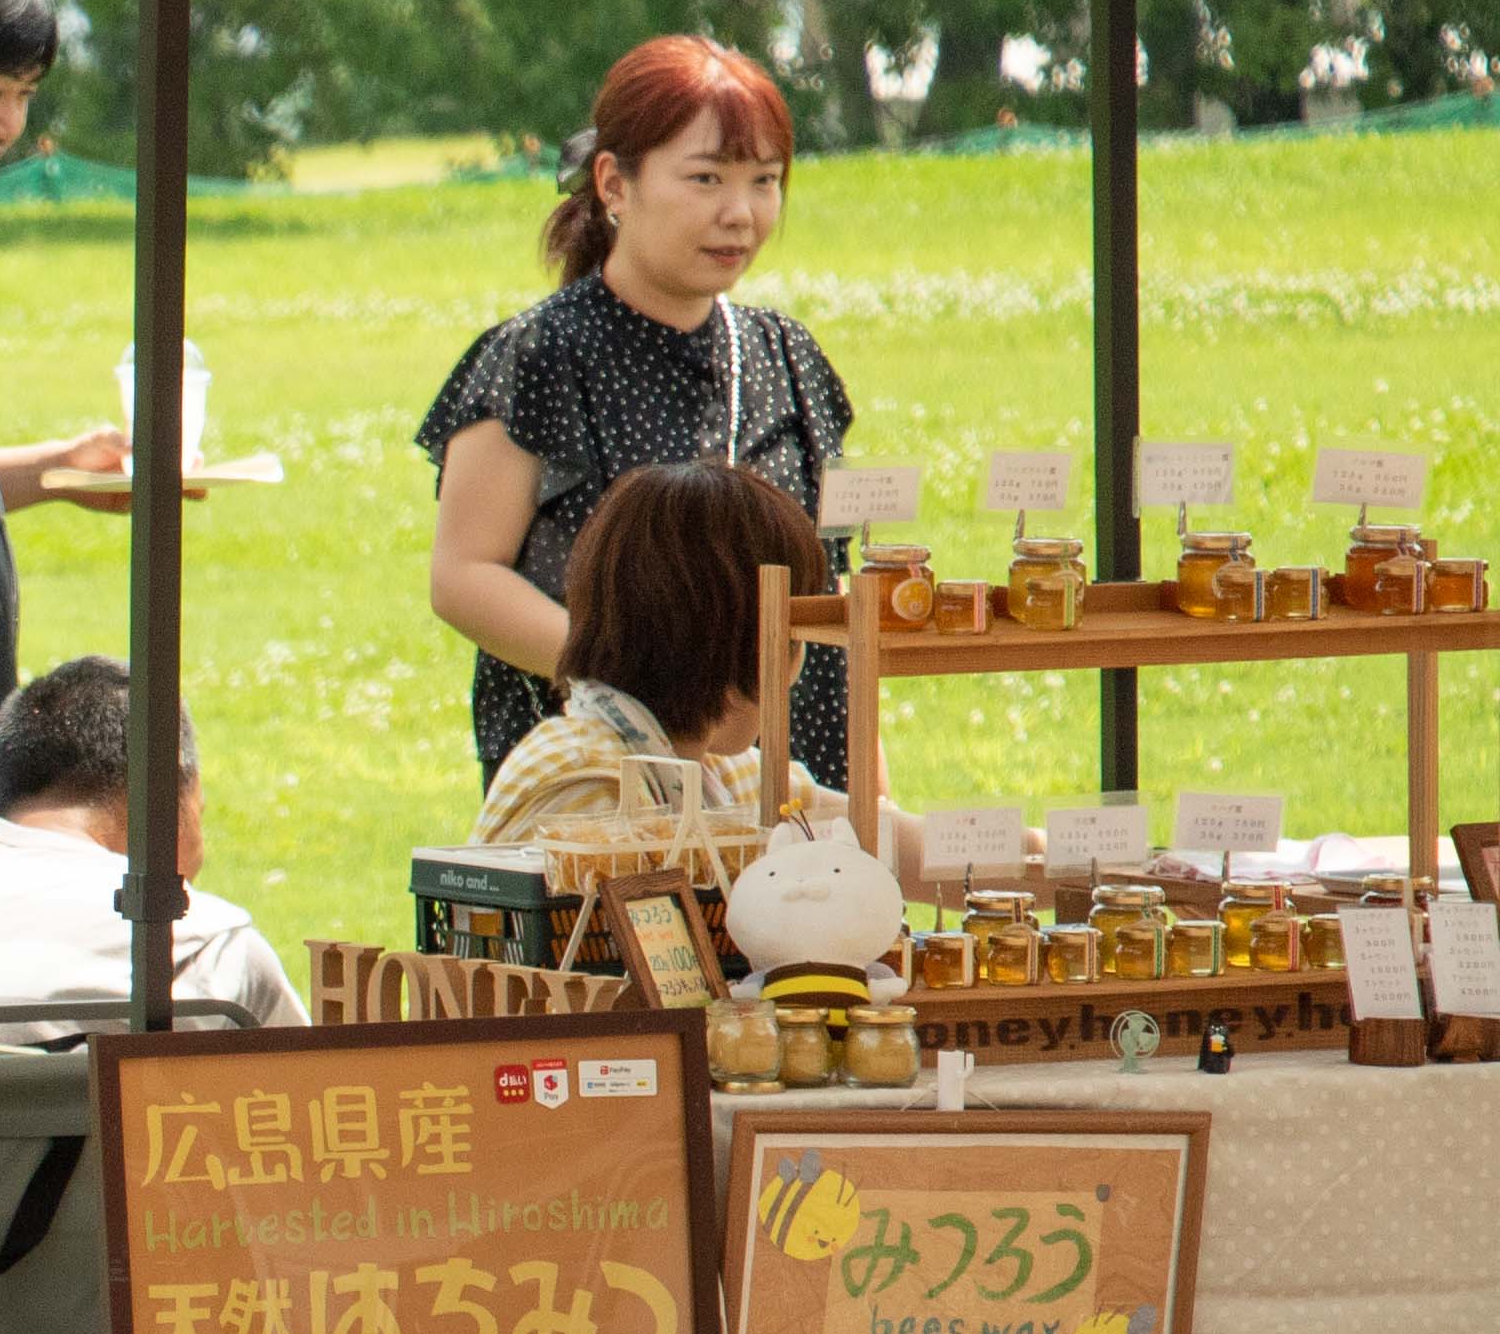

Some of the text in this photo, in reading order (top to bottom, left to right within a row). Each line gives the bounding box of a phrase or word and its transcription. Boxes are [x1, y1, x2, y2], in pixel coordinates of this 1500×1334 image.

[440, 870, 464, 887] niko
[466, 873, 487, 890] and
[304, 939, 627, 1026] HONEY
[141, 1082, 474, 1190] 広島県産
[144, 1188, 669, 1252] Harvested in Hiroshima
[841, 1202, 1093, 1304] みつろう
